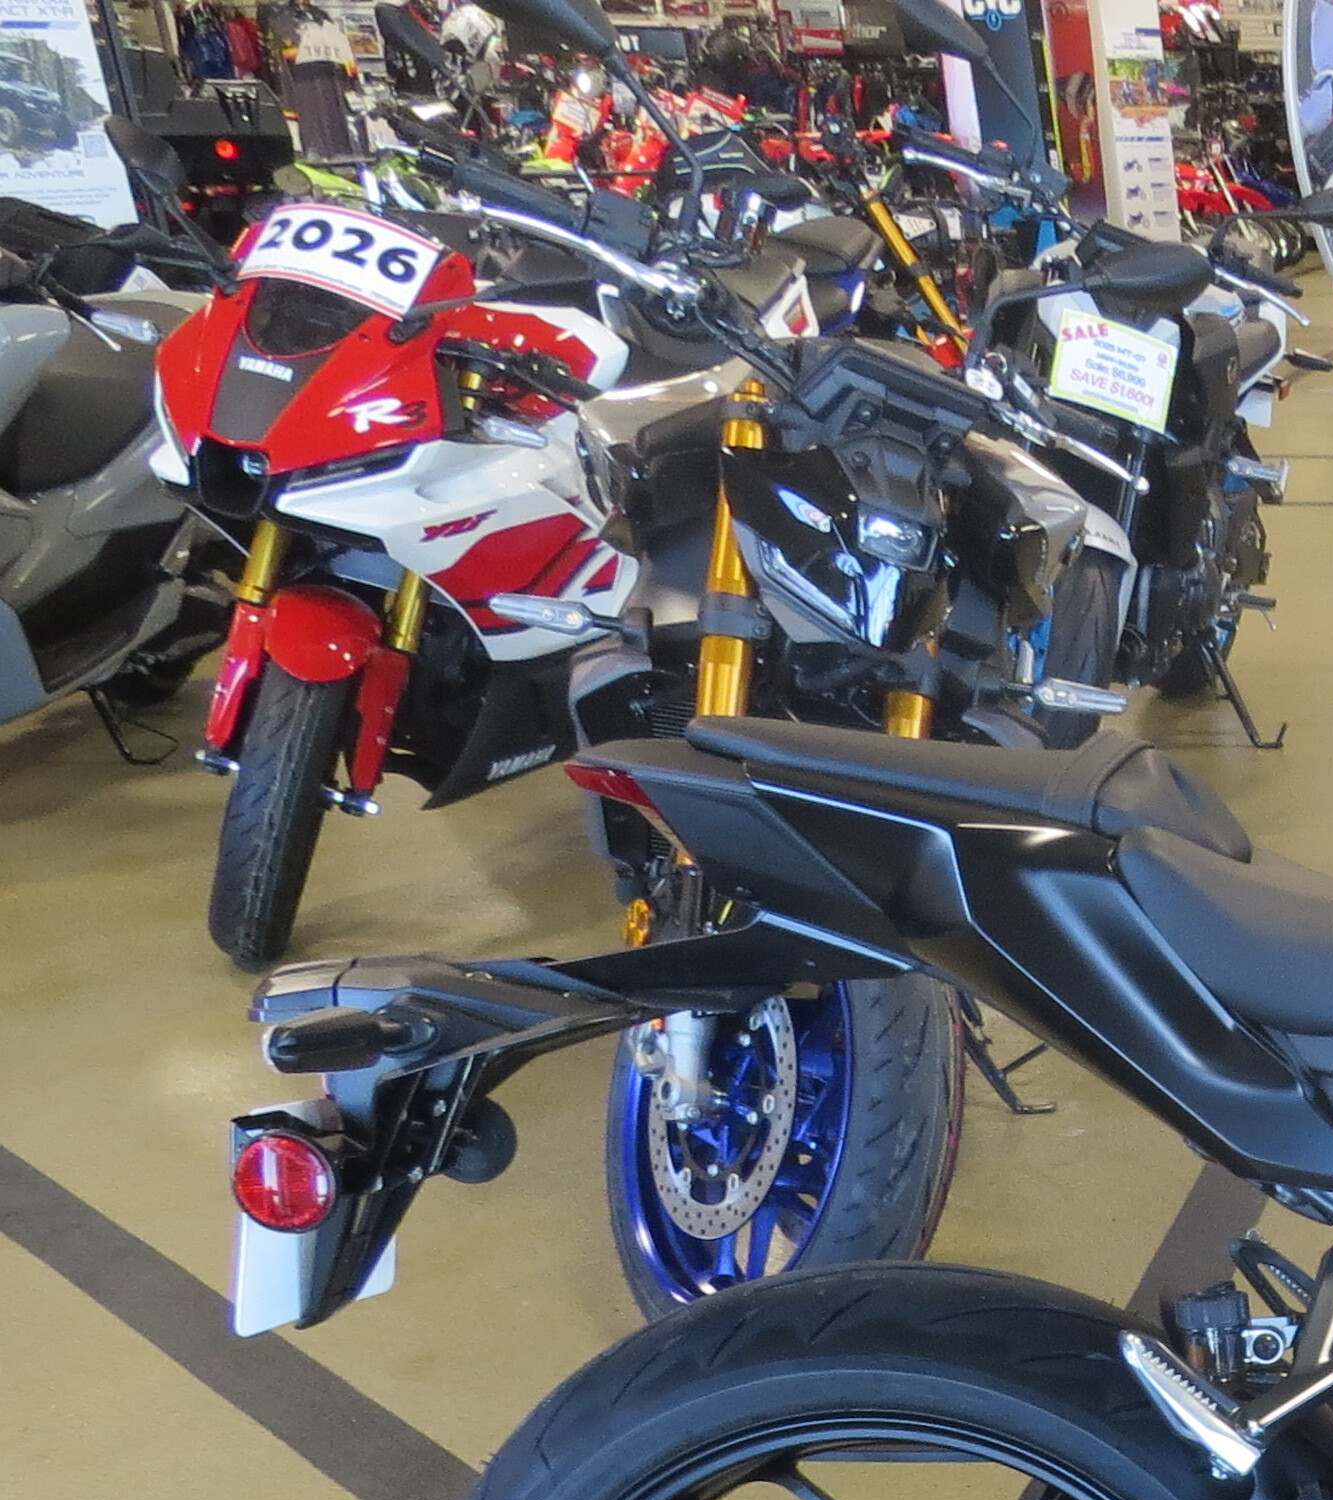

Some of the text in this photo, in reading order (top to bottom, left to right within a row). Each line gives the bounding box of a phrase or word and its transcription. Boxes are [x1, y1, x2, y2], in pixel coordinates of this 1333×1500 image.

[258, 217, 419, 284] 2026
[1061, 323, 1109, 342] SALE
[238, 355, 294, 383] YAMAHA
[419, 508, 499, 543] YZF
